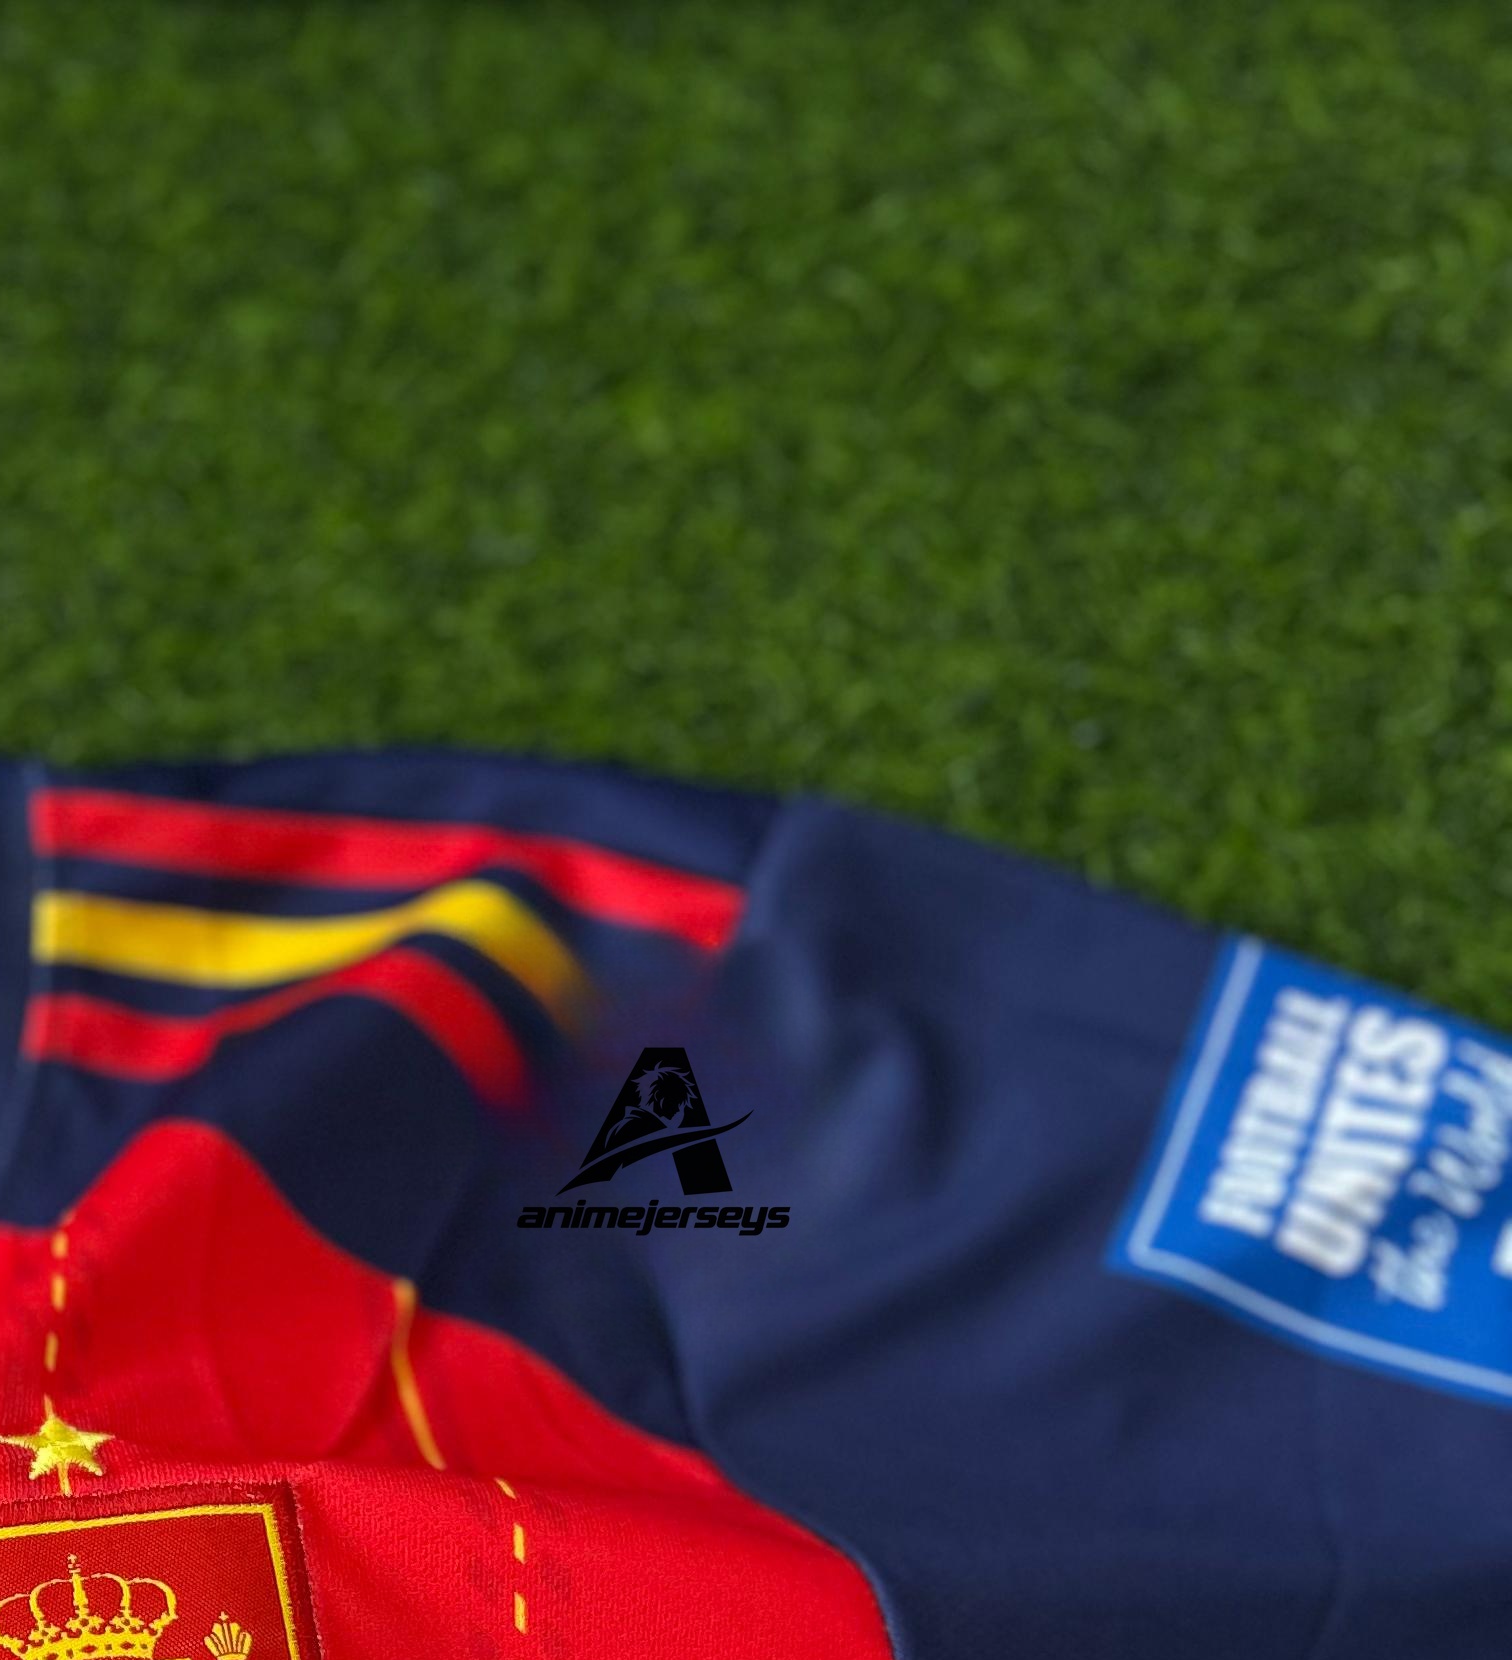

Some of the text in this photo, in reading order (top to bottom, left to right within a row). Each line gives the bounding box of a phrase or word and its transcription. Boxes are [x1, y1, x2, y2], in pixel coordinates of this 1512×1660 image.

[1198, 987, 1350, 1239] FOOTBALL
[1274, 1005, 1449, 1280] UNITES
[1370, 1212, 1459, 1311] the
